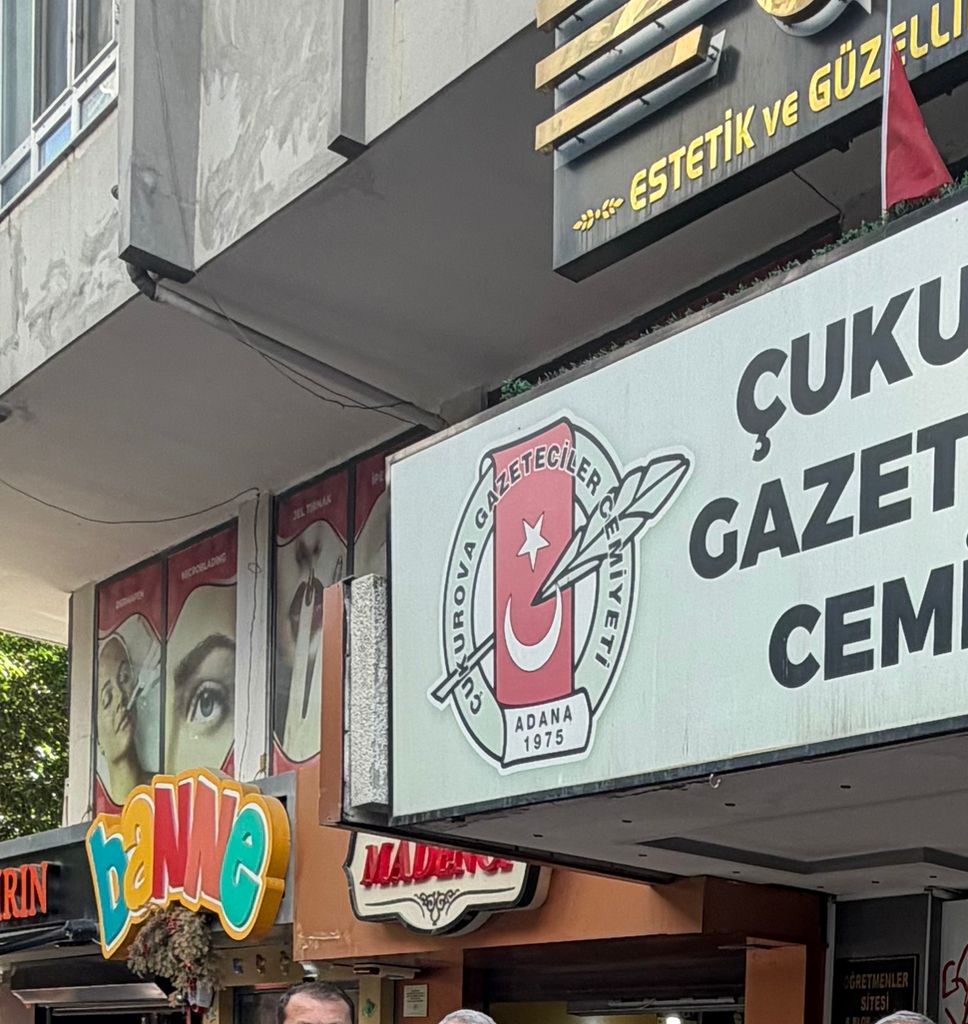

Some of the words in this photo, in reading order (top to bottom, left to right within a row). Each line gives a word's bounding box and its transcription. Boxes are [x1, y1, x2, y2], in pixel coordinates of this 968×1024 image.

[630, 104, 756, 212] ESTETİK
[452, 540, 484, 715] ÇUKUROVA
[475, 440, 601, 530] GAZETECİLER
[594, 493, 628, 669] CEMİYETİ
[515, 704, 573, 733] ADANA
[523, 728, 565, 752] 1975
[0, 861, 48, 920] RIN
